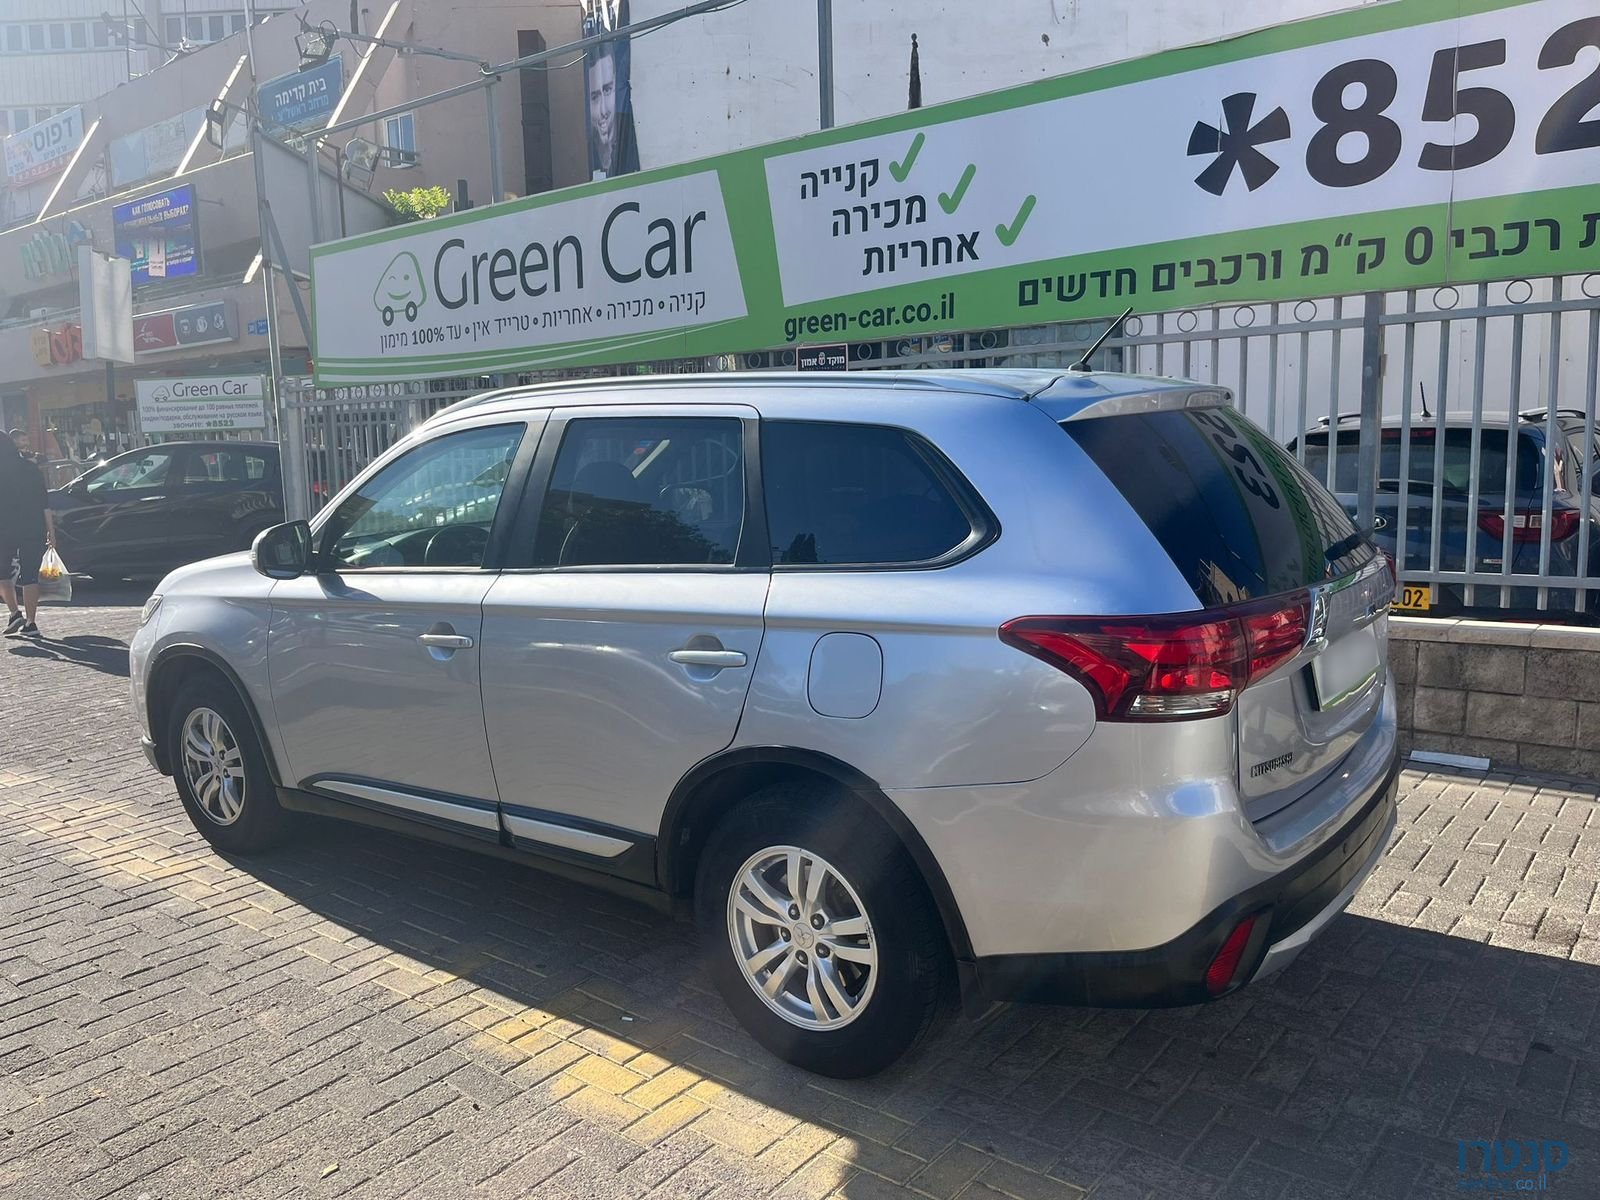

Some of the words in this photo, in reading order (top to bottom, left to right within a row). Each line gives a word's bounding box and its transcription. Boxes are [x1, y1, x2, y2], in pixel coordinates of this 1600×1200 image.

[275, 84, 306, 107] קדימה
[309, 78, 327, 95] בית
[33, 116, 73, 152] דפוס
[801, 158, 879, 199] קנייה
[832, 195, 927, 237] מכירה
[1406, 227, 1433, 266] 0
[1451, 218, 1561, 260] רכבי
[433, 234, 584, 310] Green
[601, 201, 707, 284] Car
[863, 231, 980, 276] אחריות
[1152, 249, 1282, 293] ורכבים
[1019, 267, 1137, 307] חדשים
[607, 297, 654, 320] מכירה
[670, 290, 706, 316] קניה
[494, 313, 530, 336] טרייד
[542, 304, 593, 329] אחריות
[784, 292, 955, 341] green-car.co.il
[380, 329, 409, 354] מימון
[412, 326, 445, 346] 100%
[446, 323, 462, 340] עד
[472, 318, 490, 342] אין
[800, 358, 818, 369] אמון
[827, 355, 845, 366] מוקד
[172, 382, 218, 397] Green
[222, 380, 248, 395] Car
